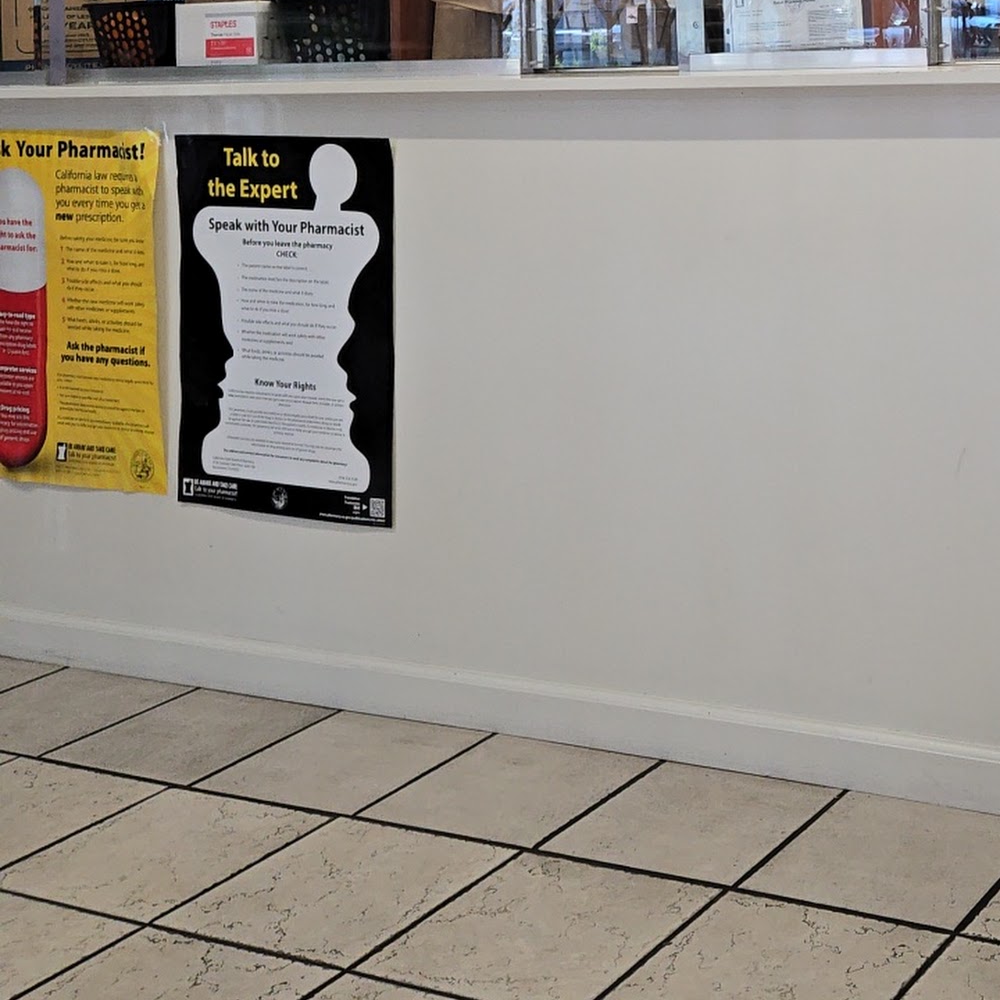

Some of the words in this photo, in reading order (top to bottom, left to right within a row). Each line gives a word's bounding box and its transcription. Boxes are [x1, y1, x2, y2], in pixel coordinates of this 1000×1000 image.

[210, 20, 237, 28] STAPLES
[16, 140, 53, 158] Your
[57, 140, 145, 160] Pharmacist!
[223, 147, 258, 167] Talk
[261, 150, 280, 168] to
[55, 169, 92, 181] California
[93, 170, 107, 180] law
[55, 184, 98, 195] pharmacist
[100, 185, 109, 195] to
[110, 186, 131, 197] speak
[208, 177, 236, 197] the
[240, 178, 298, 204] Expert
[55, 199, 70, 209] you
[72, 199, 94, 209] every
[95, 199, 113, 208] time
[115, 200, 129, 211] you
[55, 212, 73, 221] new
[75, 212, 124, 225] prescription.
[208, 218, 243, 233] Speak
[245, 219, 270, 233] with
[272, 220, 298, 234] Your
[300, 222, 365, 236] Pharmacist
[242, 238, 261, 246] Before
[263, 240, 274, 248] you
[291, 240, 301, 248] the
[302, 241, 333, 251] pharmacy
[276, 250, 298, 258] CHECK
[66, 341, 80, 351] Ask
[81, 342, 94, 352] the
[96, 344, 137, 355] pharmacist
[61, 354, 74, 363] you
[76, 353, 94, 363] have
[96, 356, 109, 366] any
[111, 356, 151, 367] questions.
[254, 378, 274, 387] Know
[276, 380, 292, 389] Your
[293, 381, 317, 392] Rights
